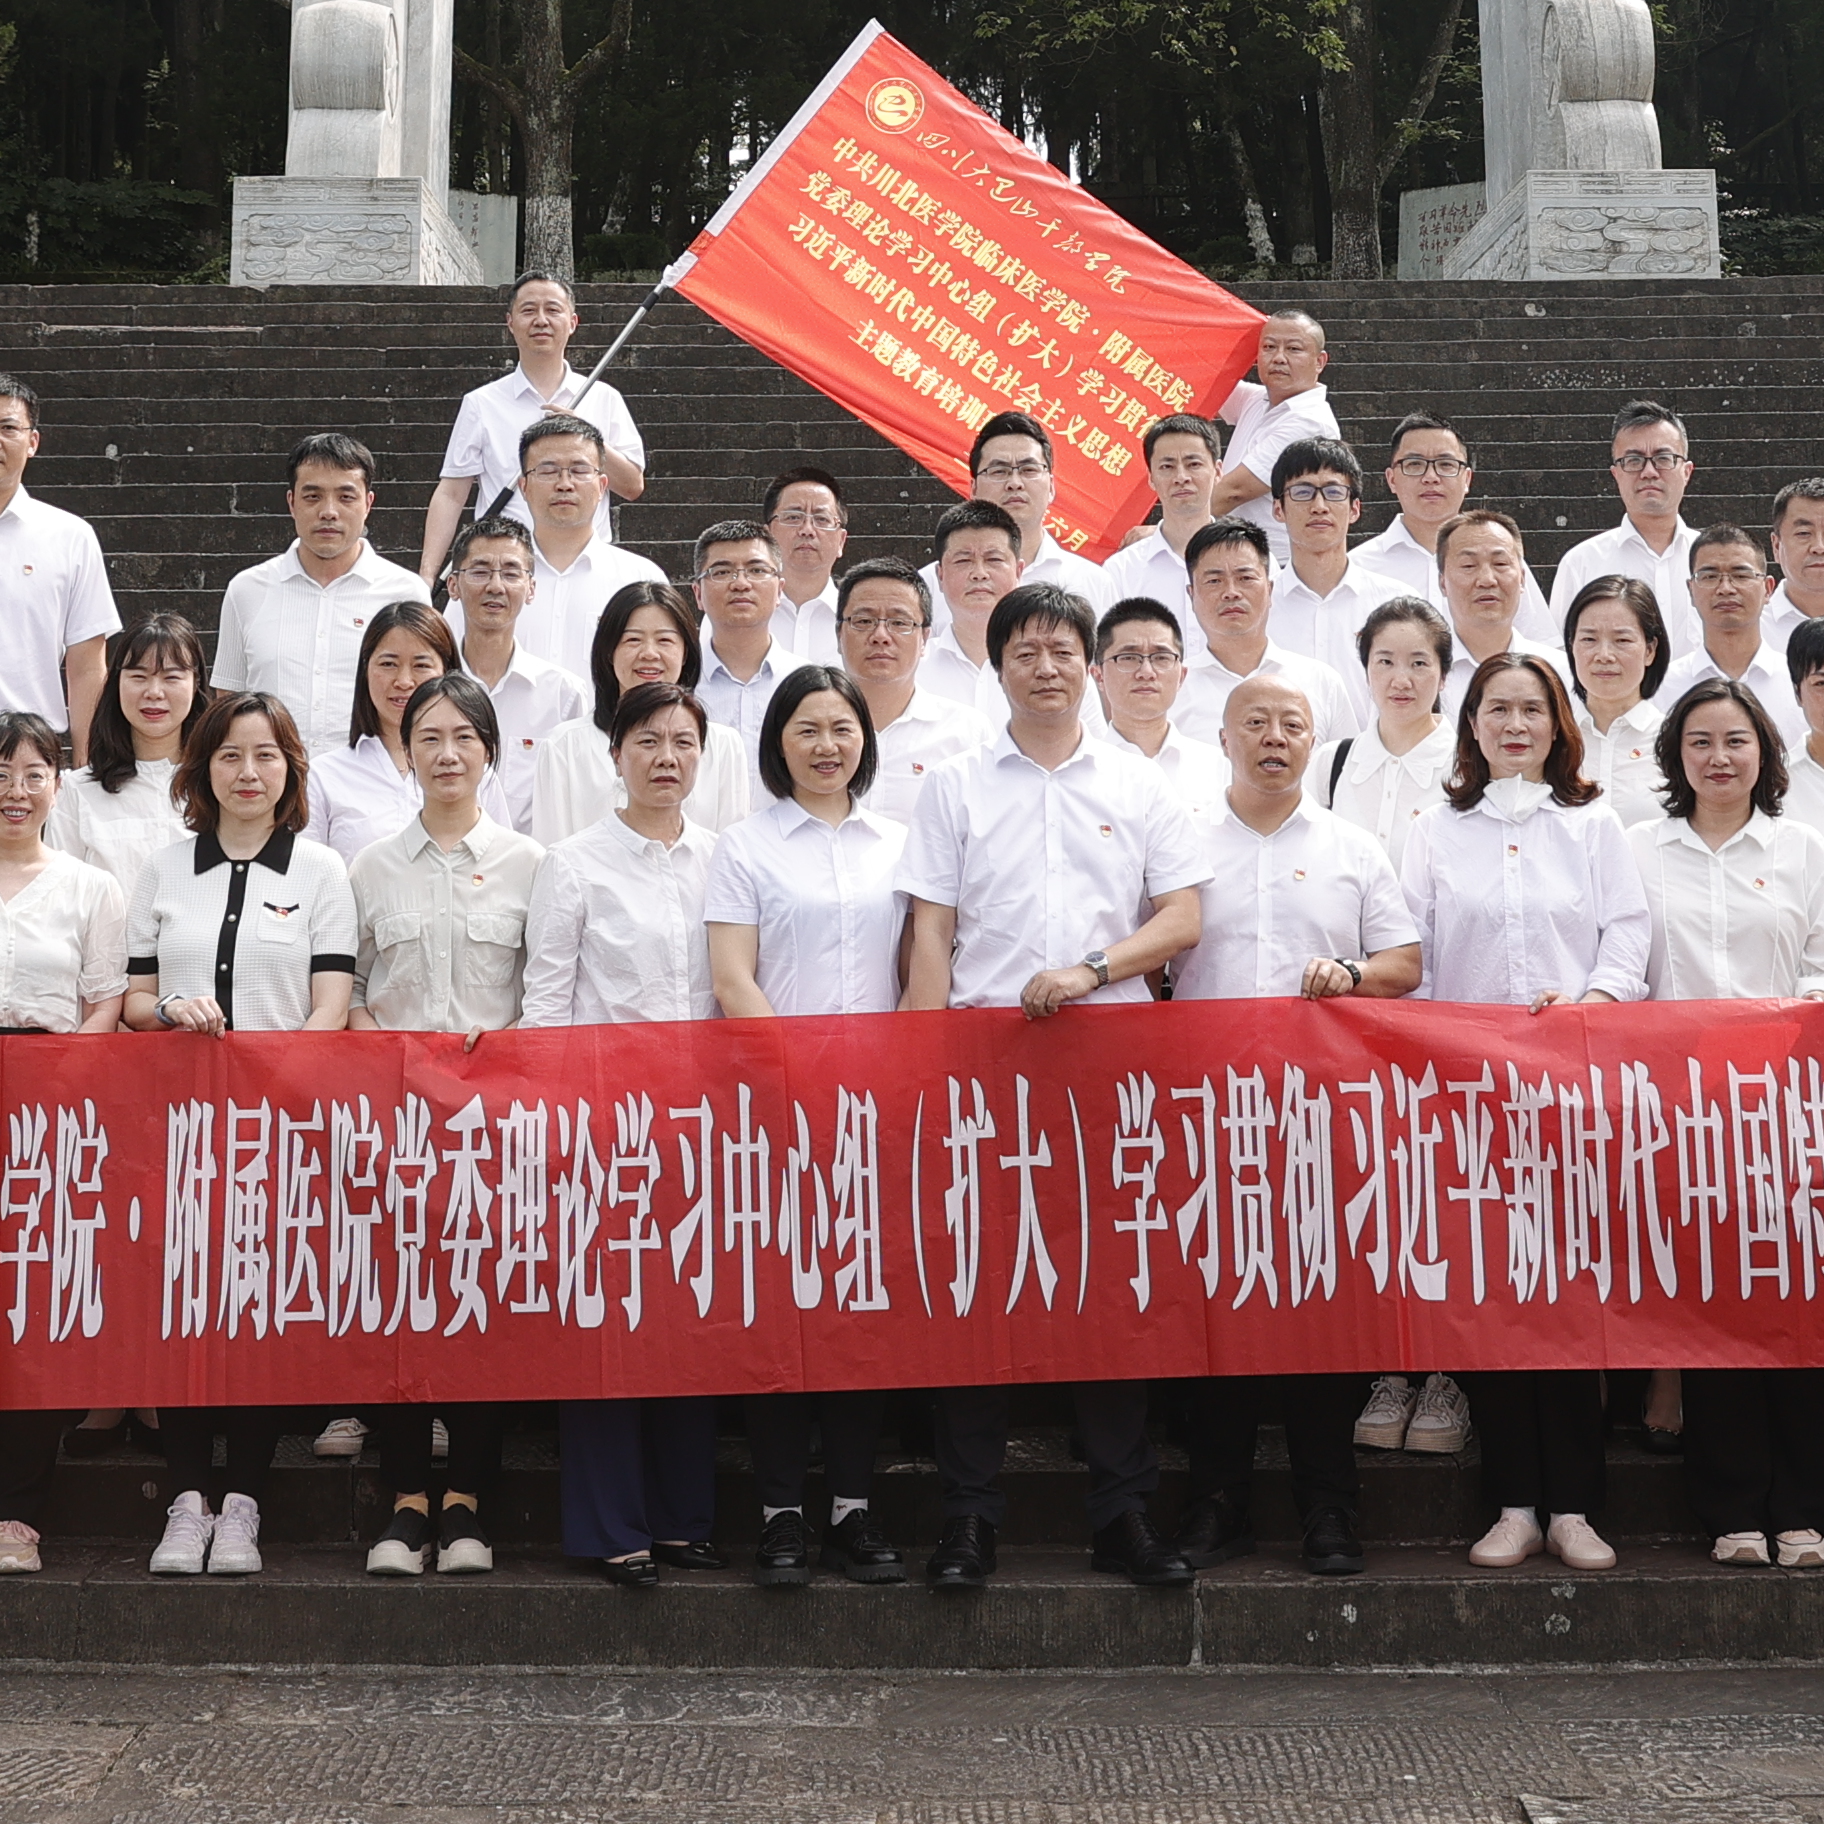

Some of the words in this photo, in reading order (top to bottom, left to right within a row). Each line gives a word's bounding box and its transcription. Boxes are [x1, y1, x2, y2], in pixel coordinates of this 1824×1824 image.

[788, 212, 1133, 476] 习近平新时代中国特色社会主义思想
